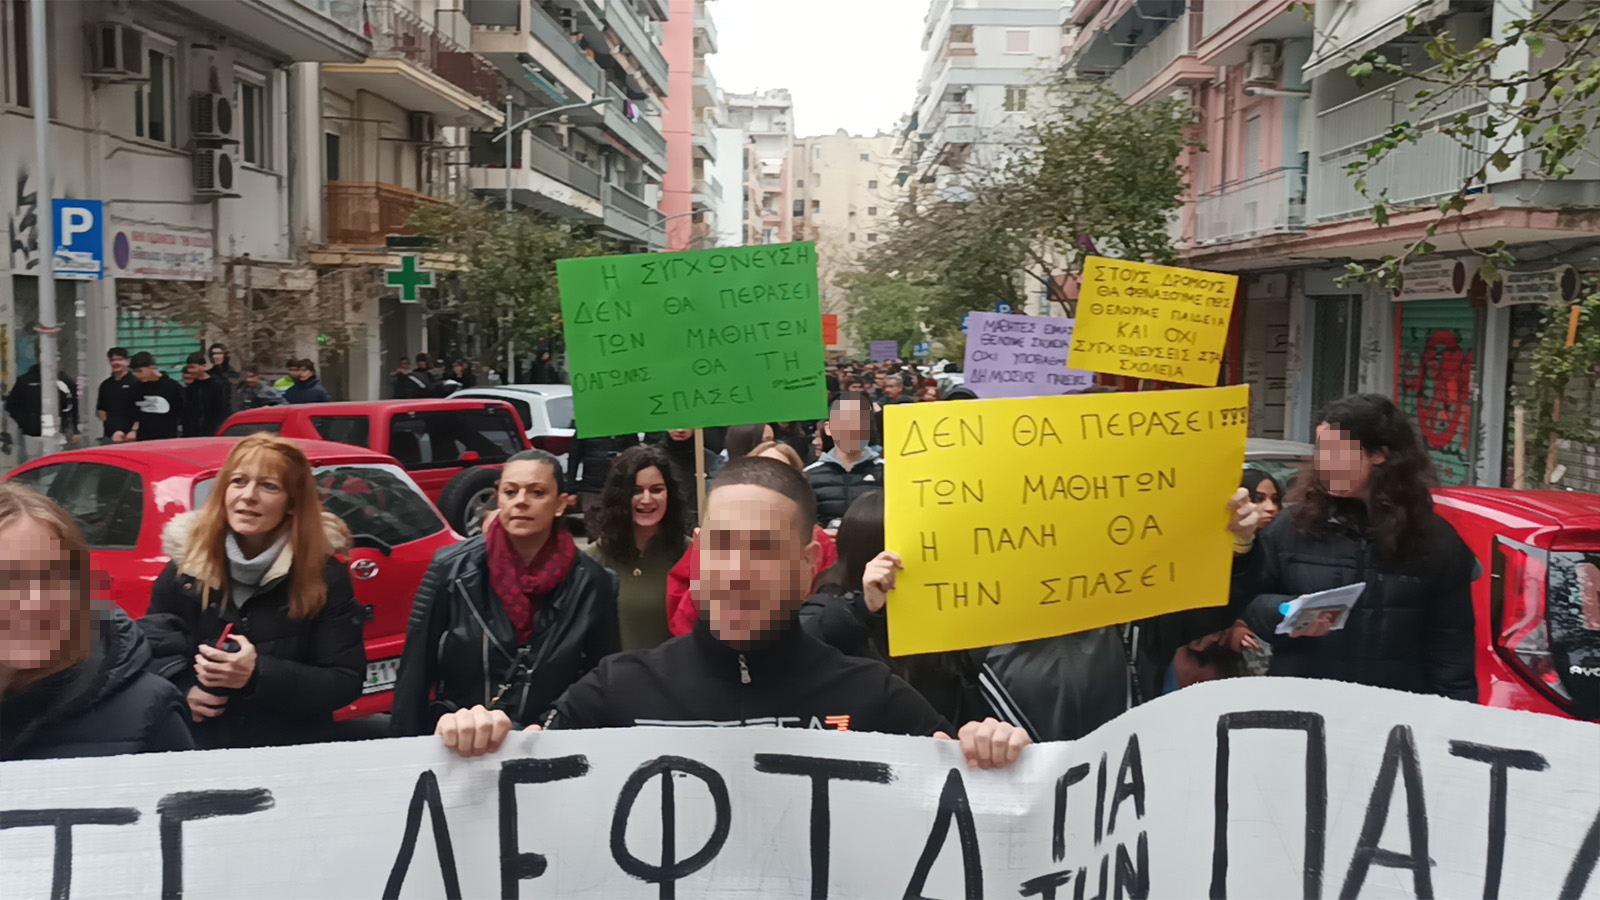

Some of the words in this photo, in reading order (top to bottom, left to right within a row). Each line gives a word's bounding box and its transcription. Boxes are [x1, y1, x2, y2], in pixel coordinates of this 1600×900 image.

[61, 207, 94, 246] P
[601, 264, 620, 290] Η
[641, 246, 808, 284] ΣΥΓΧΩΝΕΥΣΗ
[1094, 266, 1151, 284] ΣΤΟΥΣ
[1161, 273, 1225, 293] ΔΡΟΜΟΥΣ
[574, 301, 632, 324] ΔΕΝ
[664, 297, 695, 314] ΘΑ
[719, 283, 811, 309] ΠΕΡΑΣΕΙ
[1097, 286, 1120, 298] ΘΑ
[1090, 303, 1159, 318] ΘΕΛΟΥΜΕ
[1171, 311, 1225, 327] ΠΑΙΔΕΙΑ
[1117, 321, 1149, 339] ΚΑΙ
[1164, 328, 1198, 346] ΟΧΙ
[593, 332, 645, 356] ΤΩΝ
[687, 320, 807, 349] ΜΑΘΗΤΩΝ
[1073, 339, 1190, 361] ΣΥΓΧΩΝΕΥΣΕΙΣ
[692, 358, 727, 376] ΘΑ
[755, 351, 800, 371] ΤΗ
[1119, 359, 1185, 378] ΣΧΟΛΕΙΑ
[649, 385, 753, 415] ΣΠΑΣΕΙ
[900, 415, 983, 456] ΔΕΝ
[1012, 415, 1062, 446] ΘΑ
[912, 479, 983, 507] ΤΩΝ
[1022, 467, 1176, 504] ΜΑΘΗΤΩΝ
[921, 531, 938, 562] Η
[974, 524, 1057, 554] ΠΑΛΗ
[1107, 515, 1163, 545] ΘΑ
[924, 581, 1000, 611] ΤΗΝ
[1040, 562, 1175, 605] ΣΠΑΣΕΙ
[1052, 733, 1145, 863] ΓΙΑ
[381, 753, 986, 900] ΛΕΦΤΑ
